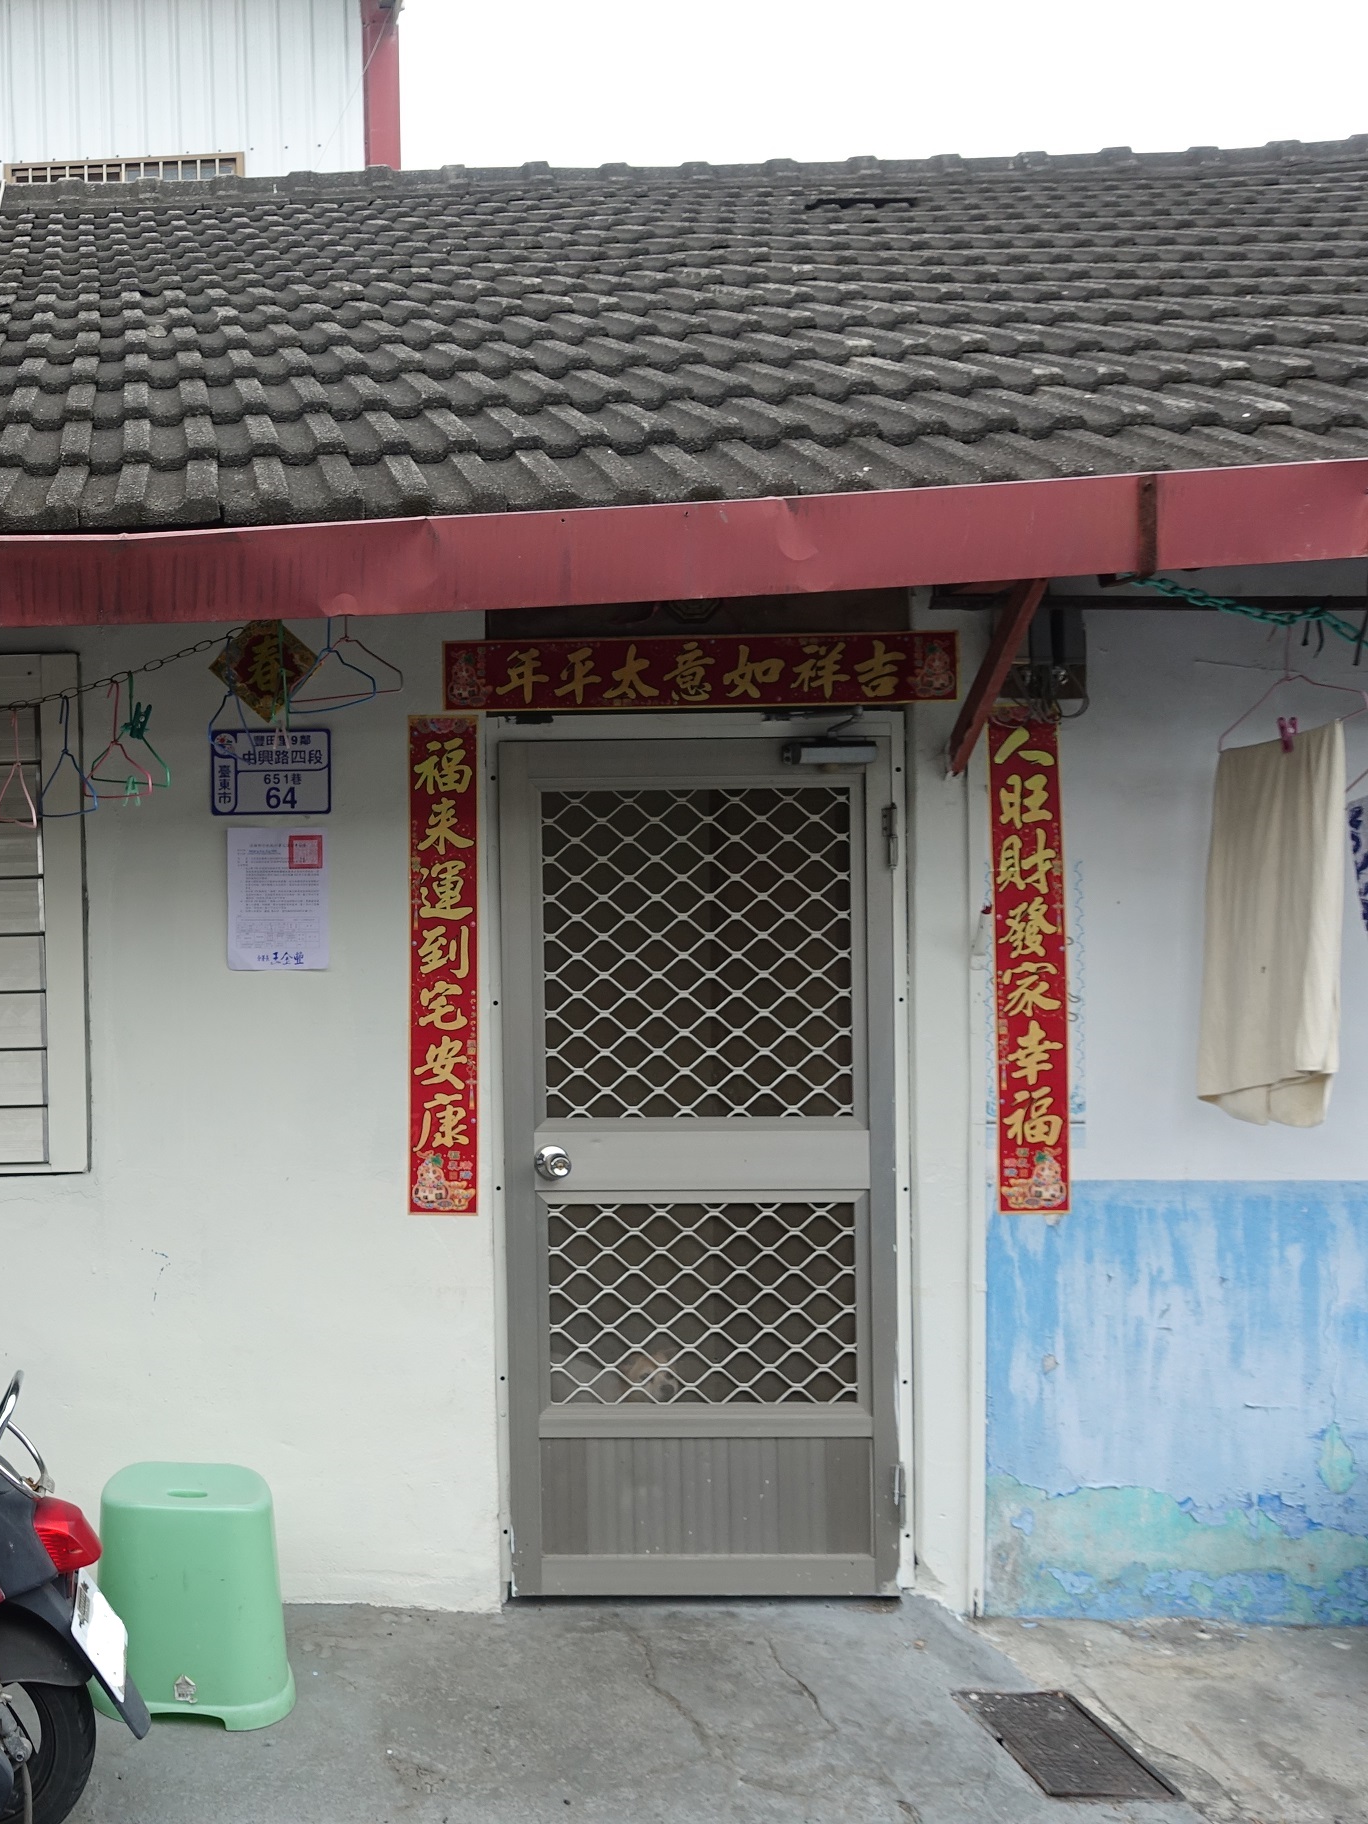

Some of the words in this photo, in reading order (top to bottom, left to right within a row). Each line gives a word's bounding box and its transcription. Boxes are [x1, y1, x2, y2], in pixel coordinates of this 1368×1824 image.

[247, 635, 295, 692] 春
[495, 639, 907, 704] 吉祥如意太平年
[242, 749, 323, 765] 中興路四段
[264, 773, 302, 785] 651巷
[217, 764, 232, 804] 臺東市
[265, 786, 298, 809] 64
[413, 740, 474, 1153] 福來運到宅安康
[994, 728, 1063, 1147] 人旺財發家幸福
